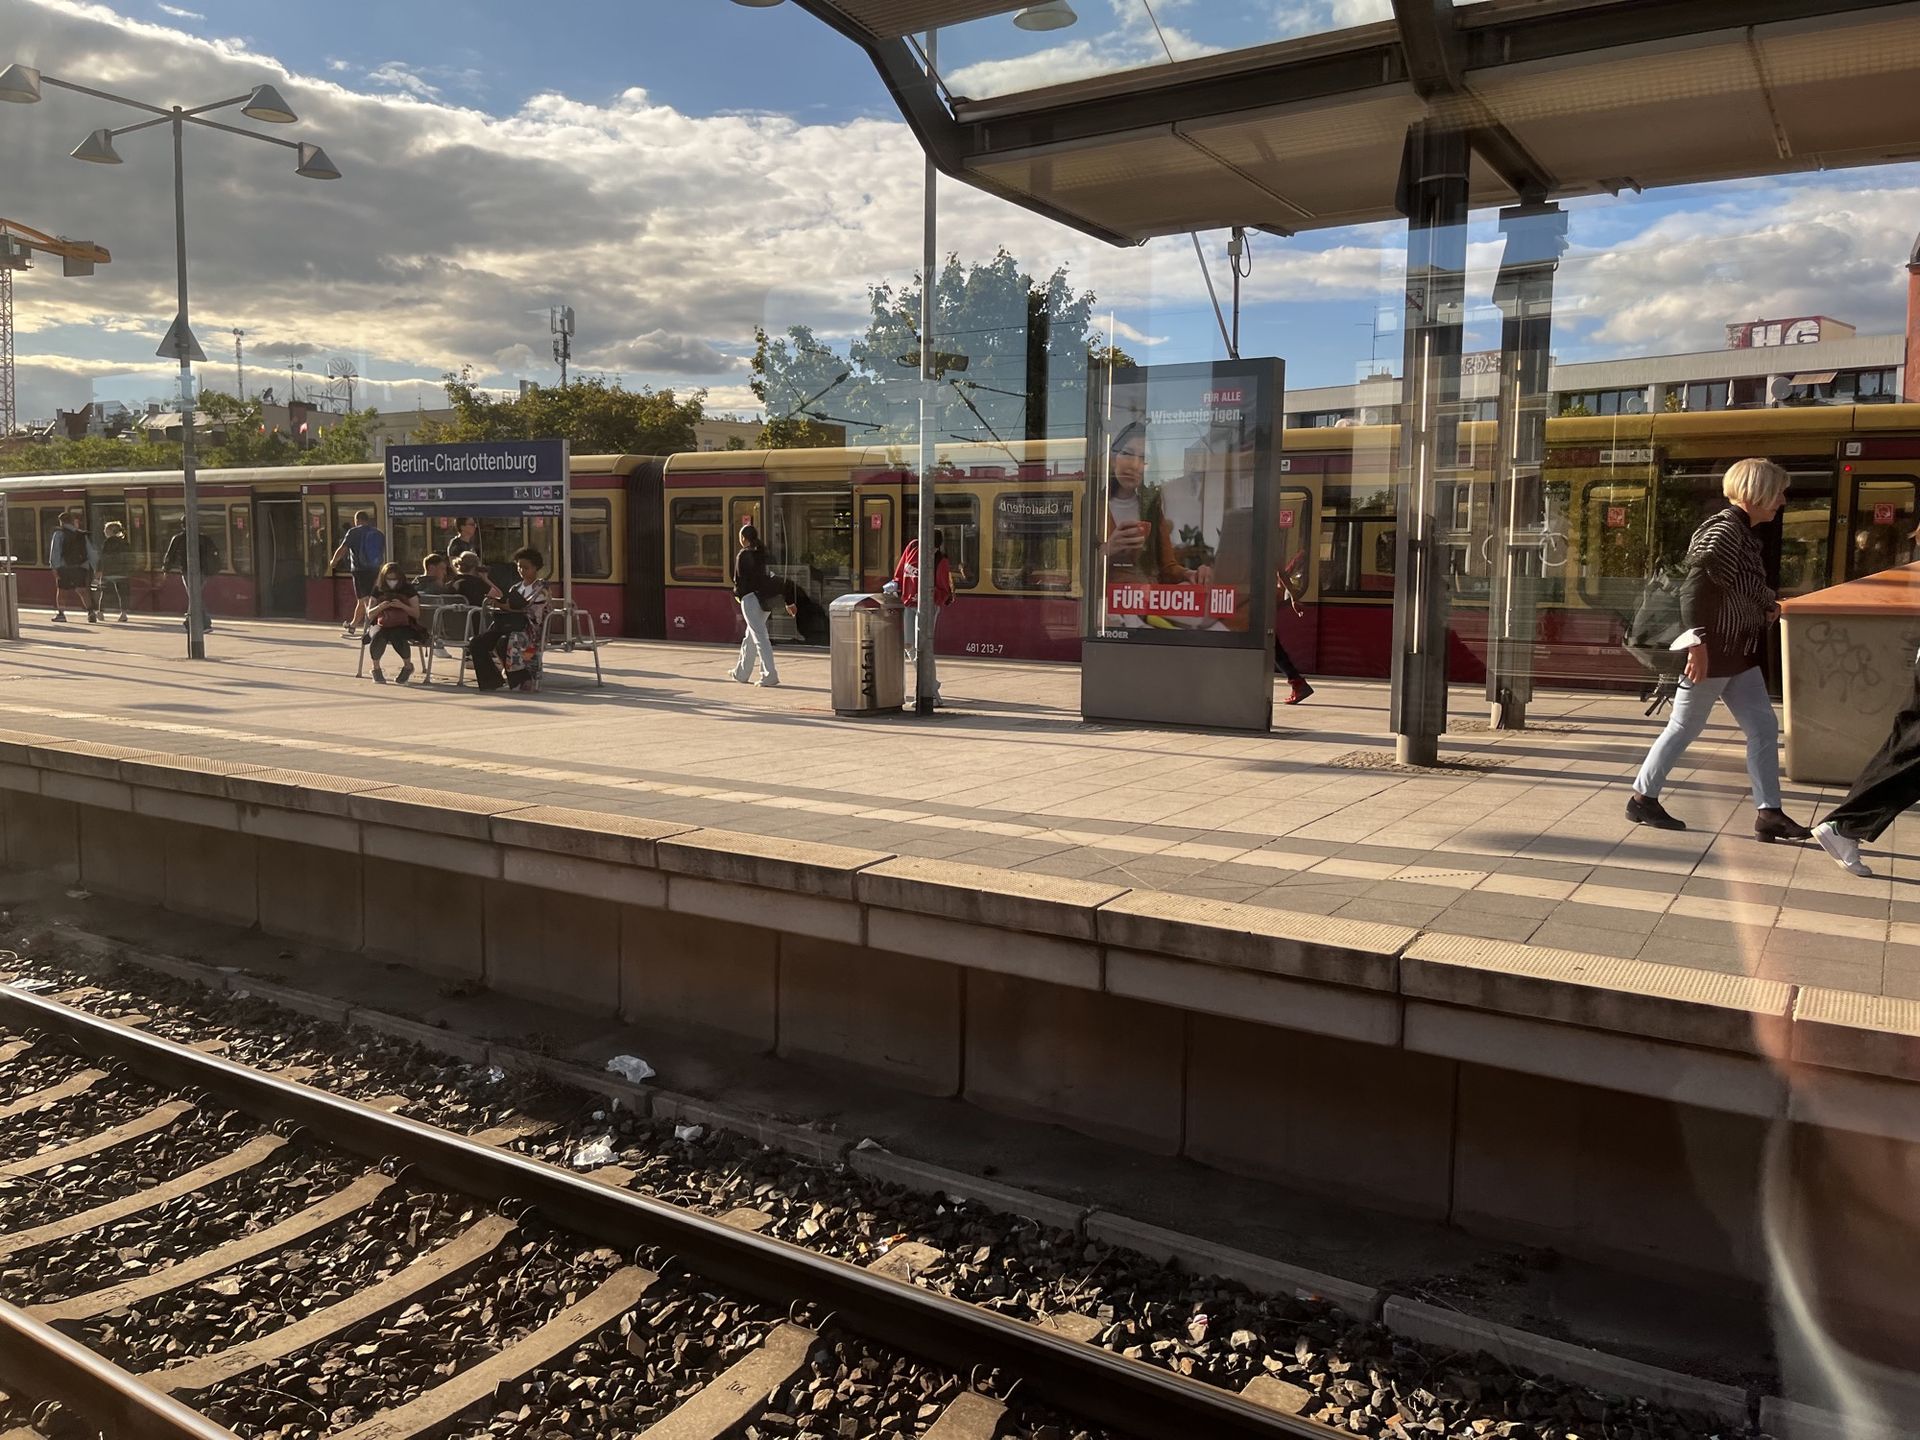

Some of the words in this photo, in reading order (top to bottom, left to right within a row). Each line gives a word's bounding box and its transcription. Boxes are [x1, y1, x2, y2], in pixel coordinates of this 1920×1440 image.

[1221, 391, 1241, 402] ALLE
[391, 451, 537, 473] Berlin-Charlottenburg
[1112, 585, 1145, 609] FÜR
[1149, 590, 1200, 611] EUCH.
[1210, 589, 1235, 614] Bild
[965, 642, 979, 653] 481
[980, 643, 1004, 654] 213-7
[861, 639, 874, 697] Abfall
